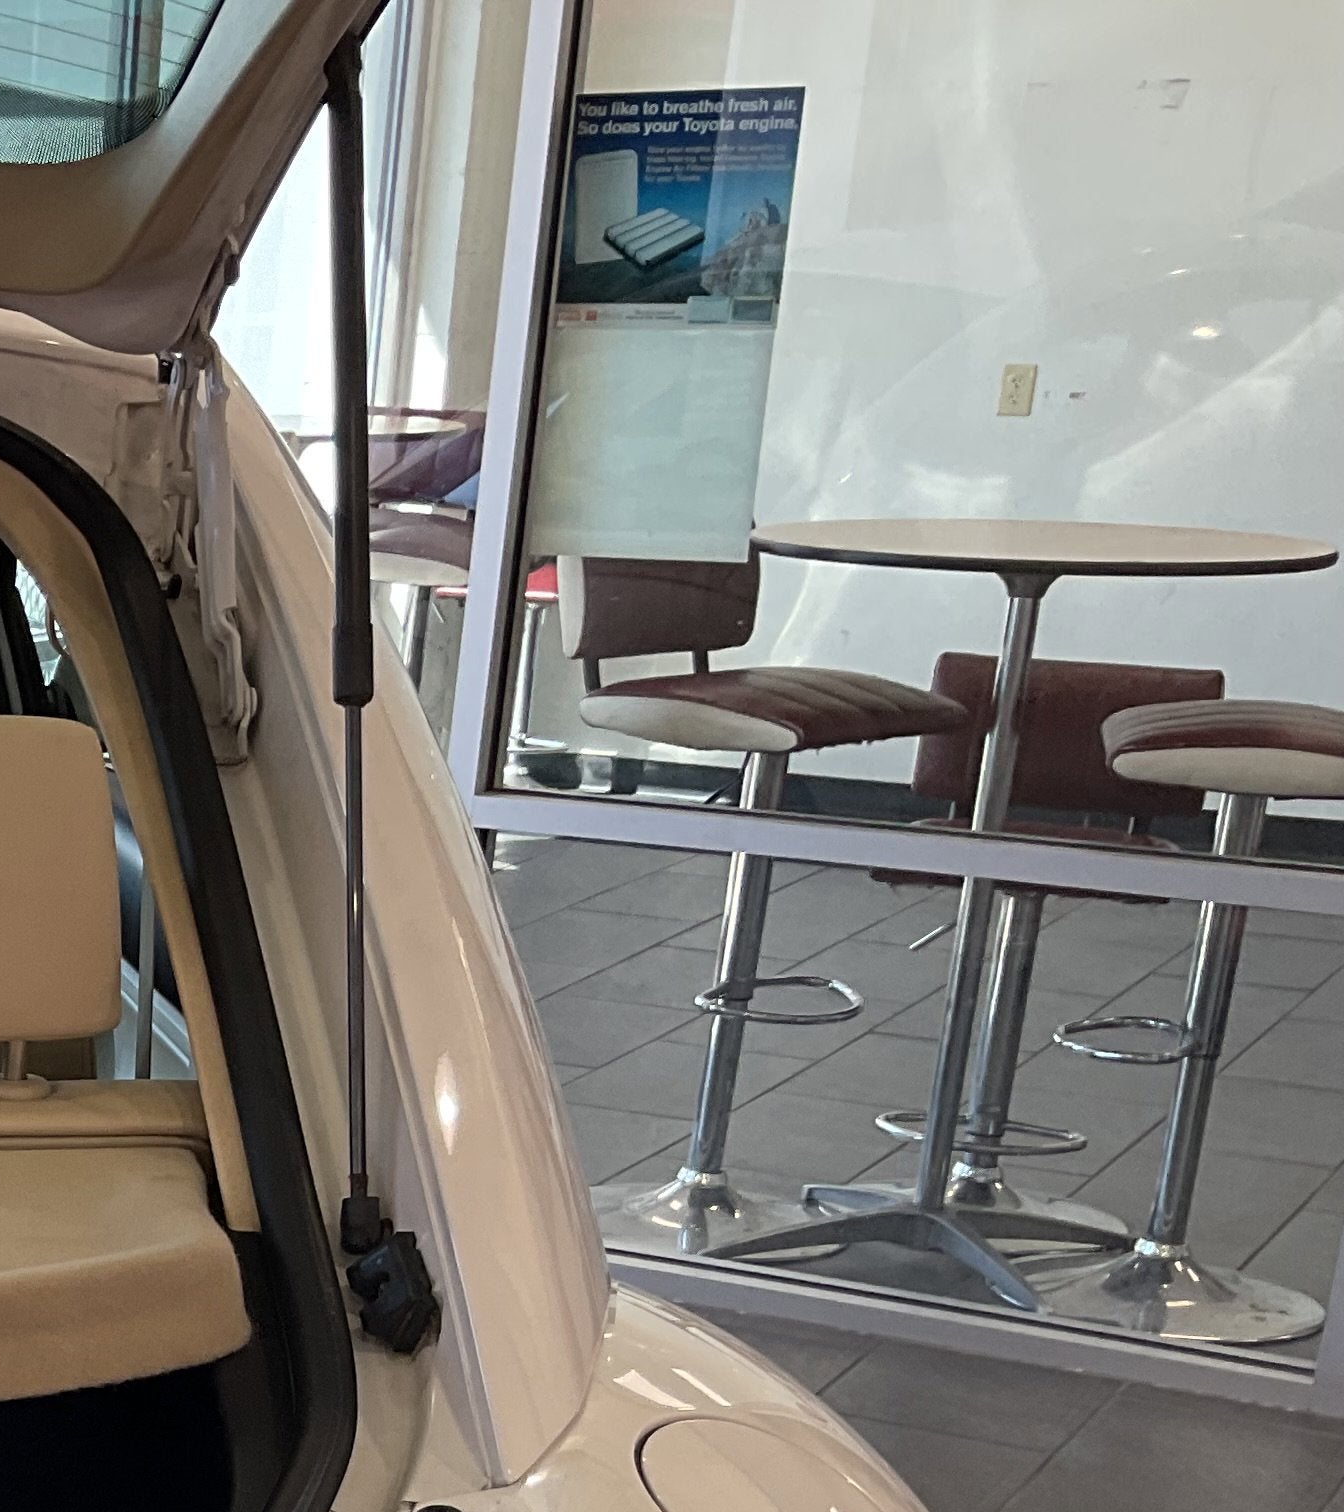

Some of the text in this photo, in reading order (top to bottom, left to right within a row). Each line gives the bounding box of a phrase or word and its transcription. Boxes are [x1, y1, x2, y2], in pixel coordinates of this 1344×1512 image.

[579, 97, 798, 117] You like to breathe fresh air.
[577, 116, 799, 136] So does your Toyota engine.
